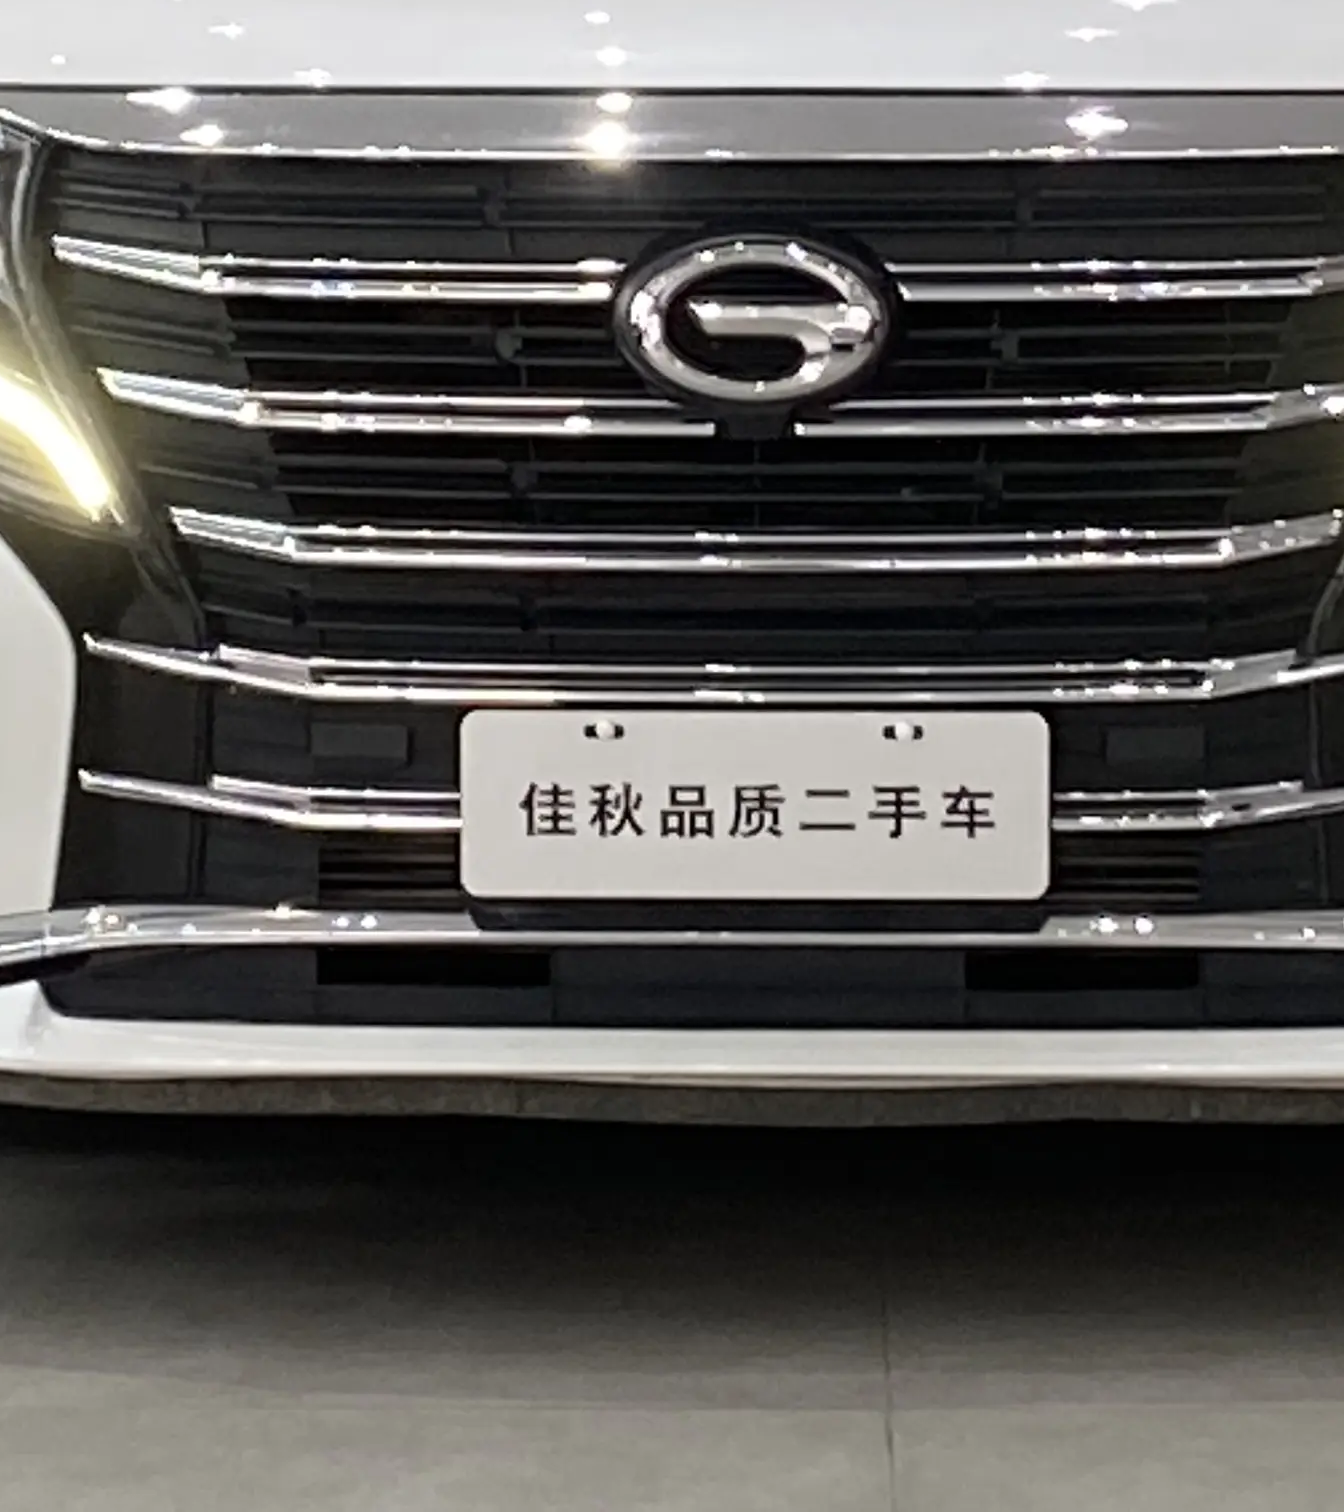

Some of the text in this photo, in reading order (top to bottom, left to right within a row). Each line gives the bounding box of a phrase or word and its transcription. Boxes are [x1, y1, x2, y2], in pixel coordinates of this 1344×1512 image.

[518, 781, 997, 839] 佳秋品质二手车
